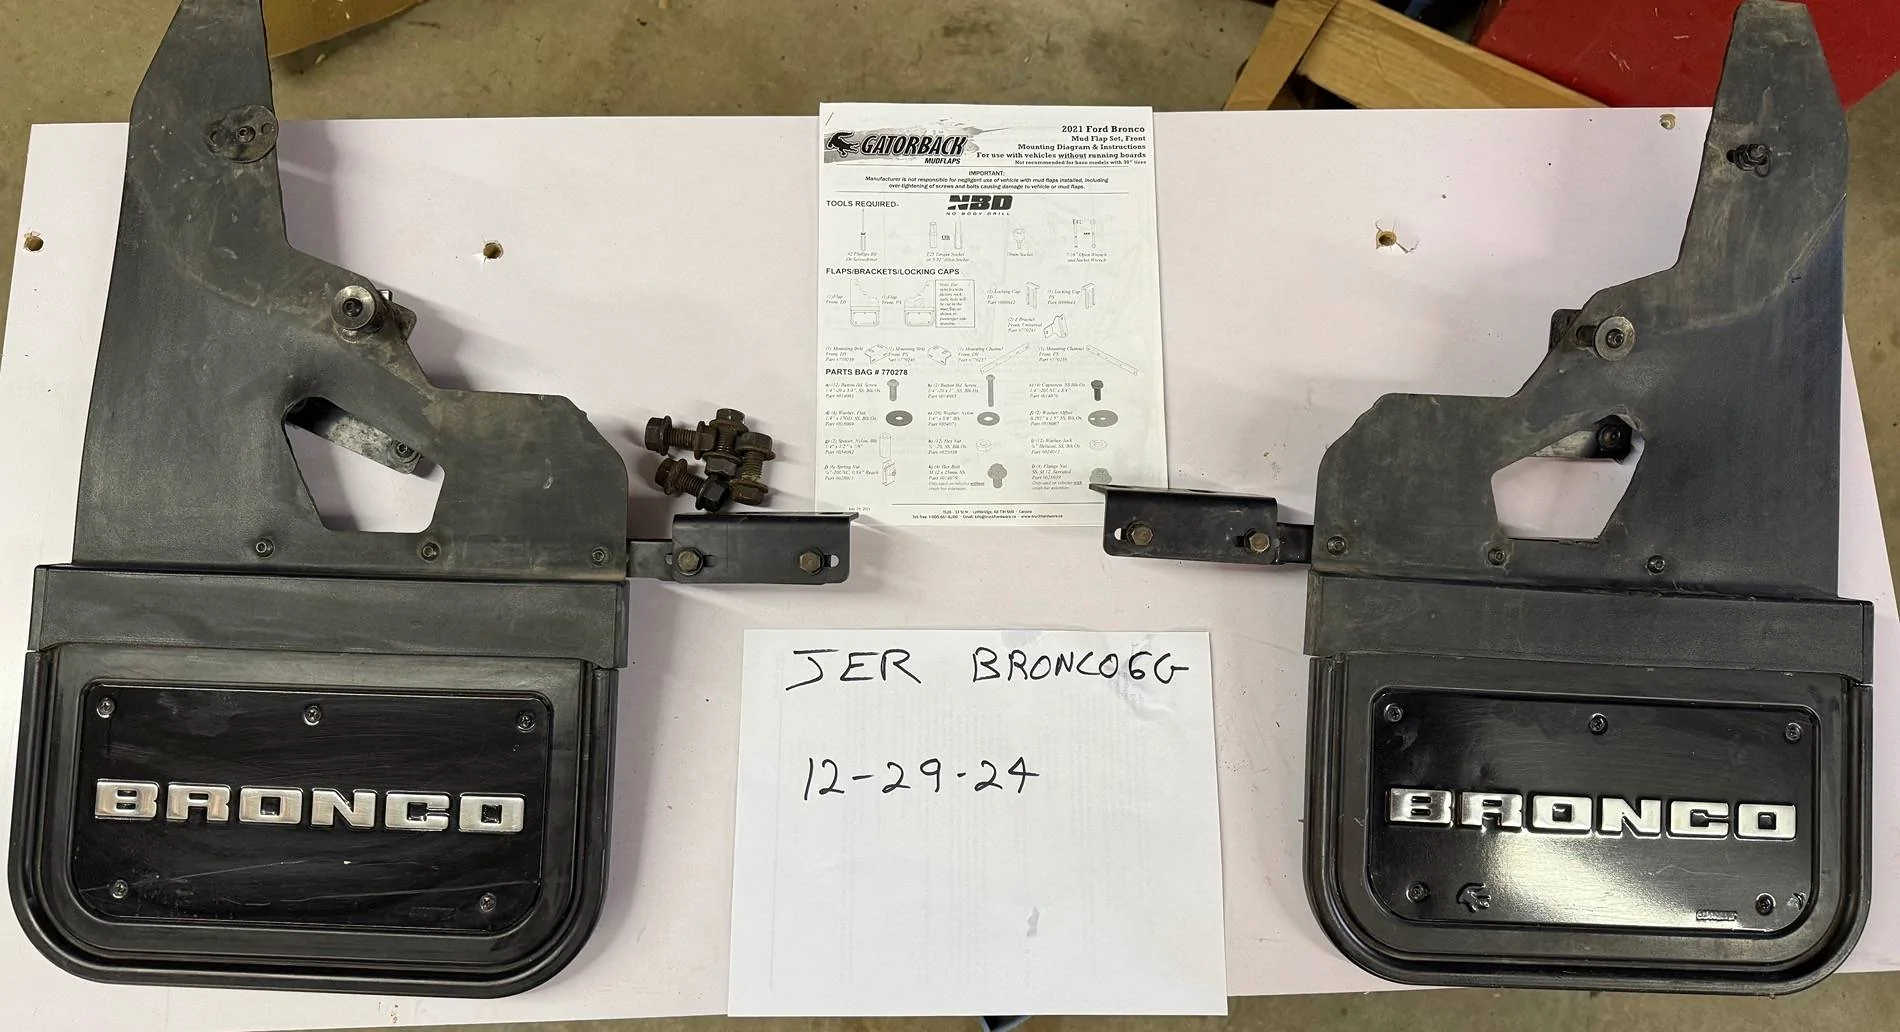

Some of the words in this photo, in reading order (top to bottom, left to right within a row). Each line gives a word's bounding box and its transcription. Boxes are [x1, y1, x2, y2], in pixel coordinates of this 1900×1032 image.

[1062, 125, 1083, 133] 2021
[1086, 125, 1108, 133] Ford
[1110, 125, 1145, 133] Bronco
[861, 135, 967, 156] GATORBACK
[924, 157, 961, 165] MUDFLAPS
[826, 200, 854, 208] TOOLS
[947, 195, 1013, 211] NBD
[825, 368, 853, 376] PARTS
[855, 368, 873, 376] BAG
[875, 368, 880, 376] #
[881, 368, 908, 376] 770278
[786, 648, 922, 690] JER
[972, 647, 1189, 683] BRONCO6G
[804, 756, 1040, 800] 12-29-24
[95, 778, 525, 833] BRONCO
[1387, 787, 1797, 840] BRONCO
